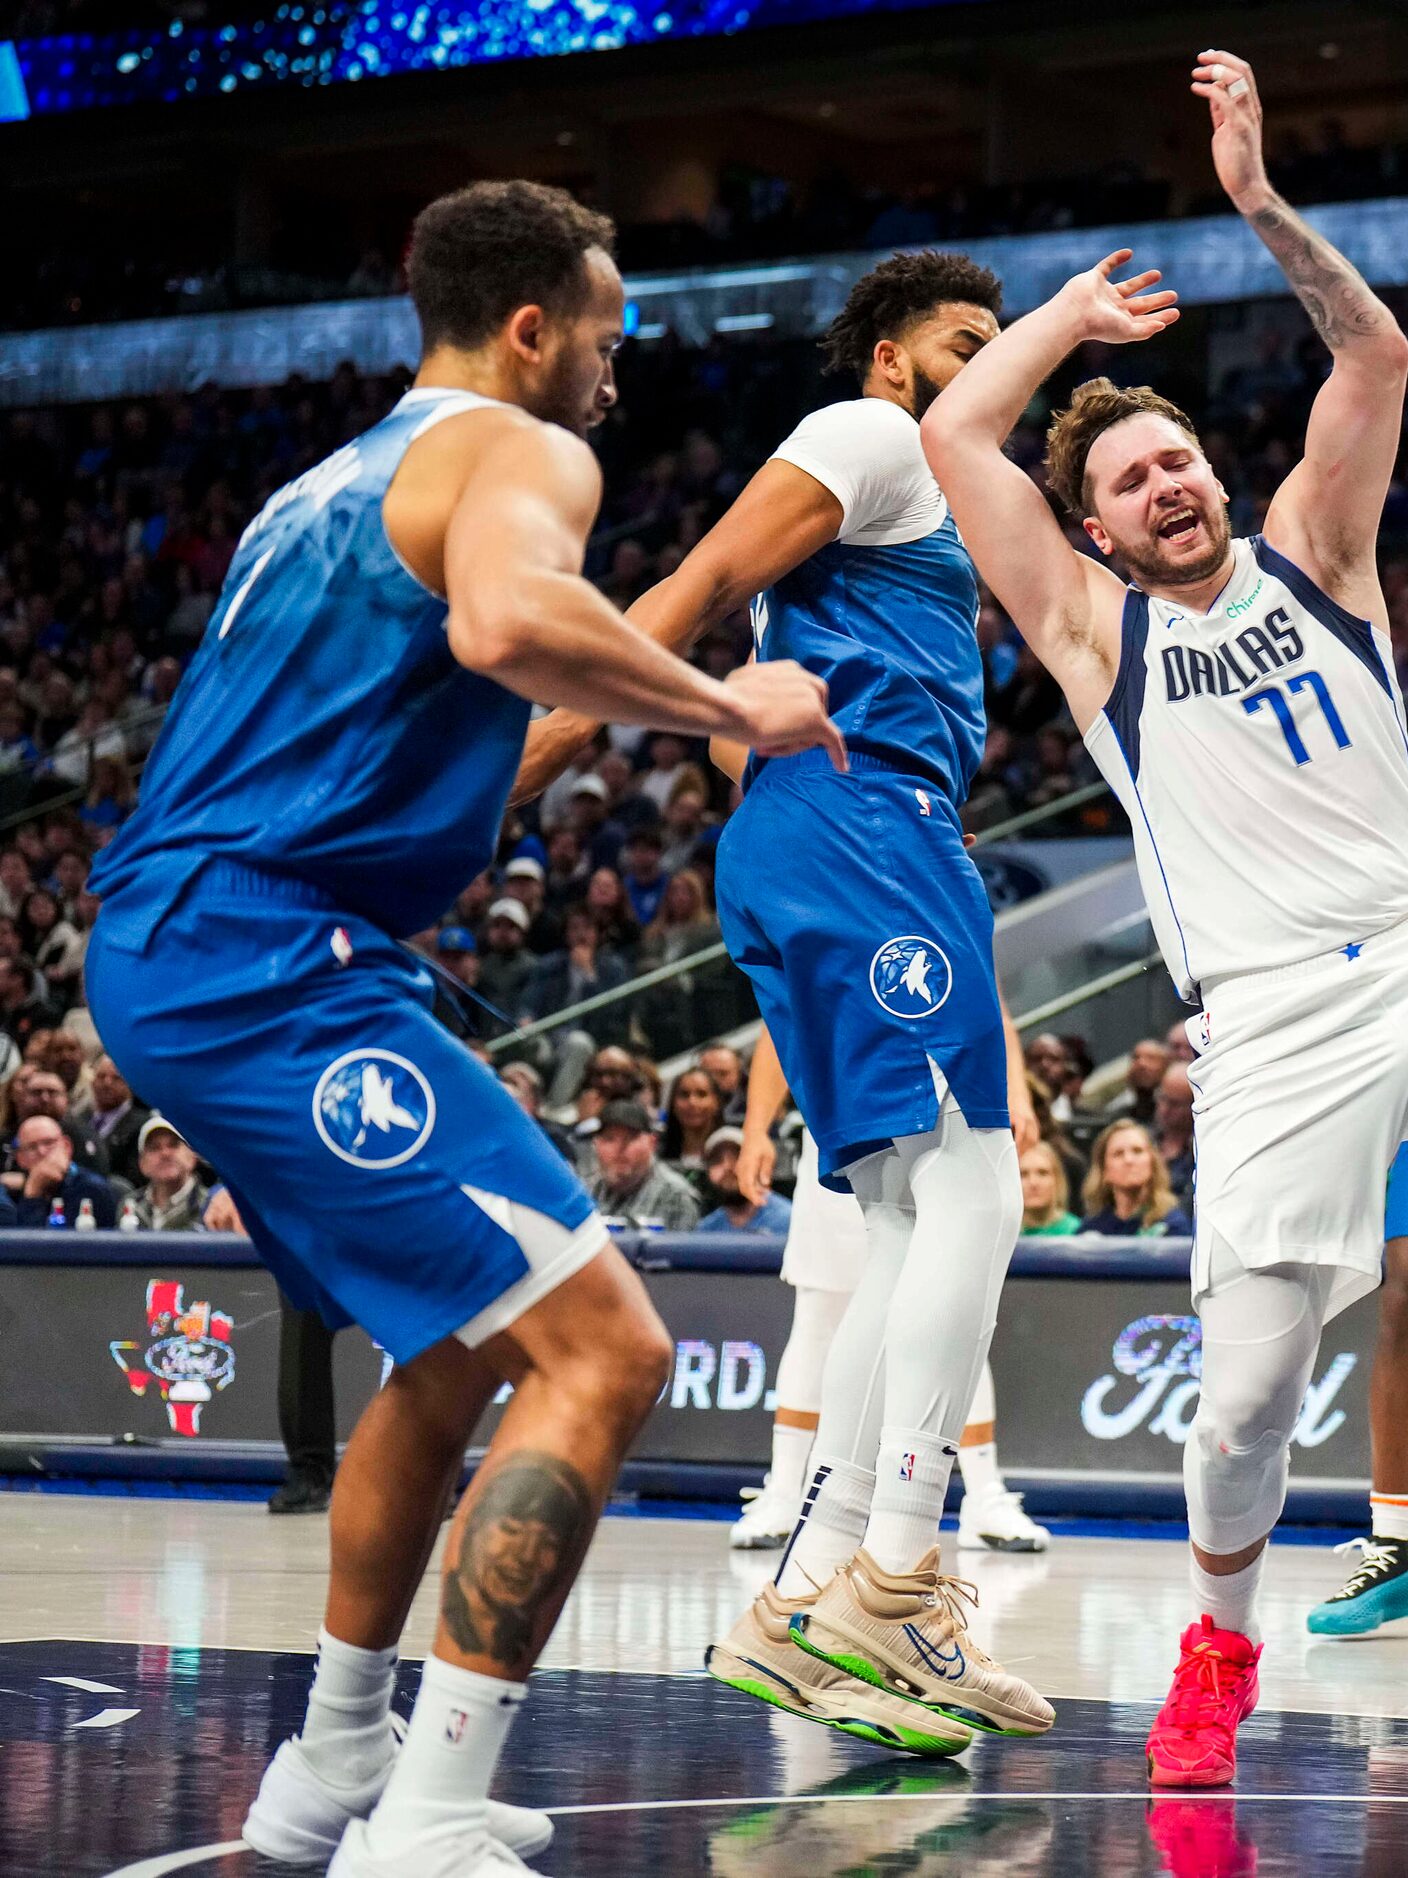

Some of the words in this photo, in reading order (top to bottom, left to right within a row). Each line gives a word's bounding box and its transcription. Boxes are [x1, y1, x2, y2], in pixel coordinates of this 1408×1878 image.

[1161, 606, 1306, 705] DALLAS
[1239, 669, 1354, 768] 77
[1080, 1313, 1358, 1448] Fod
